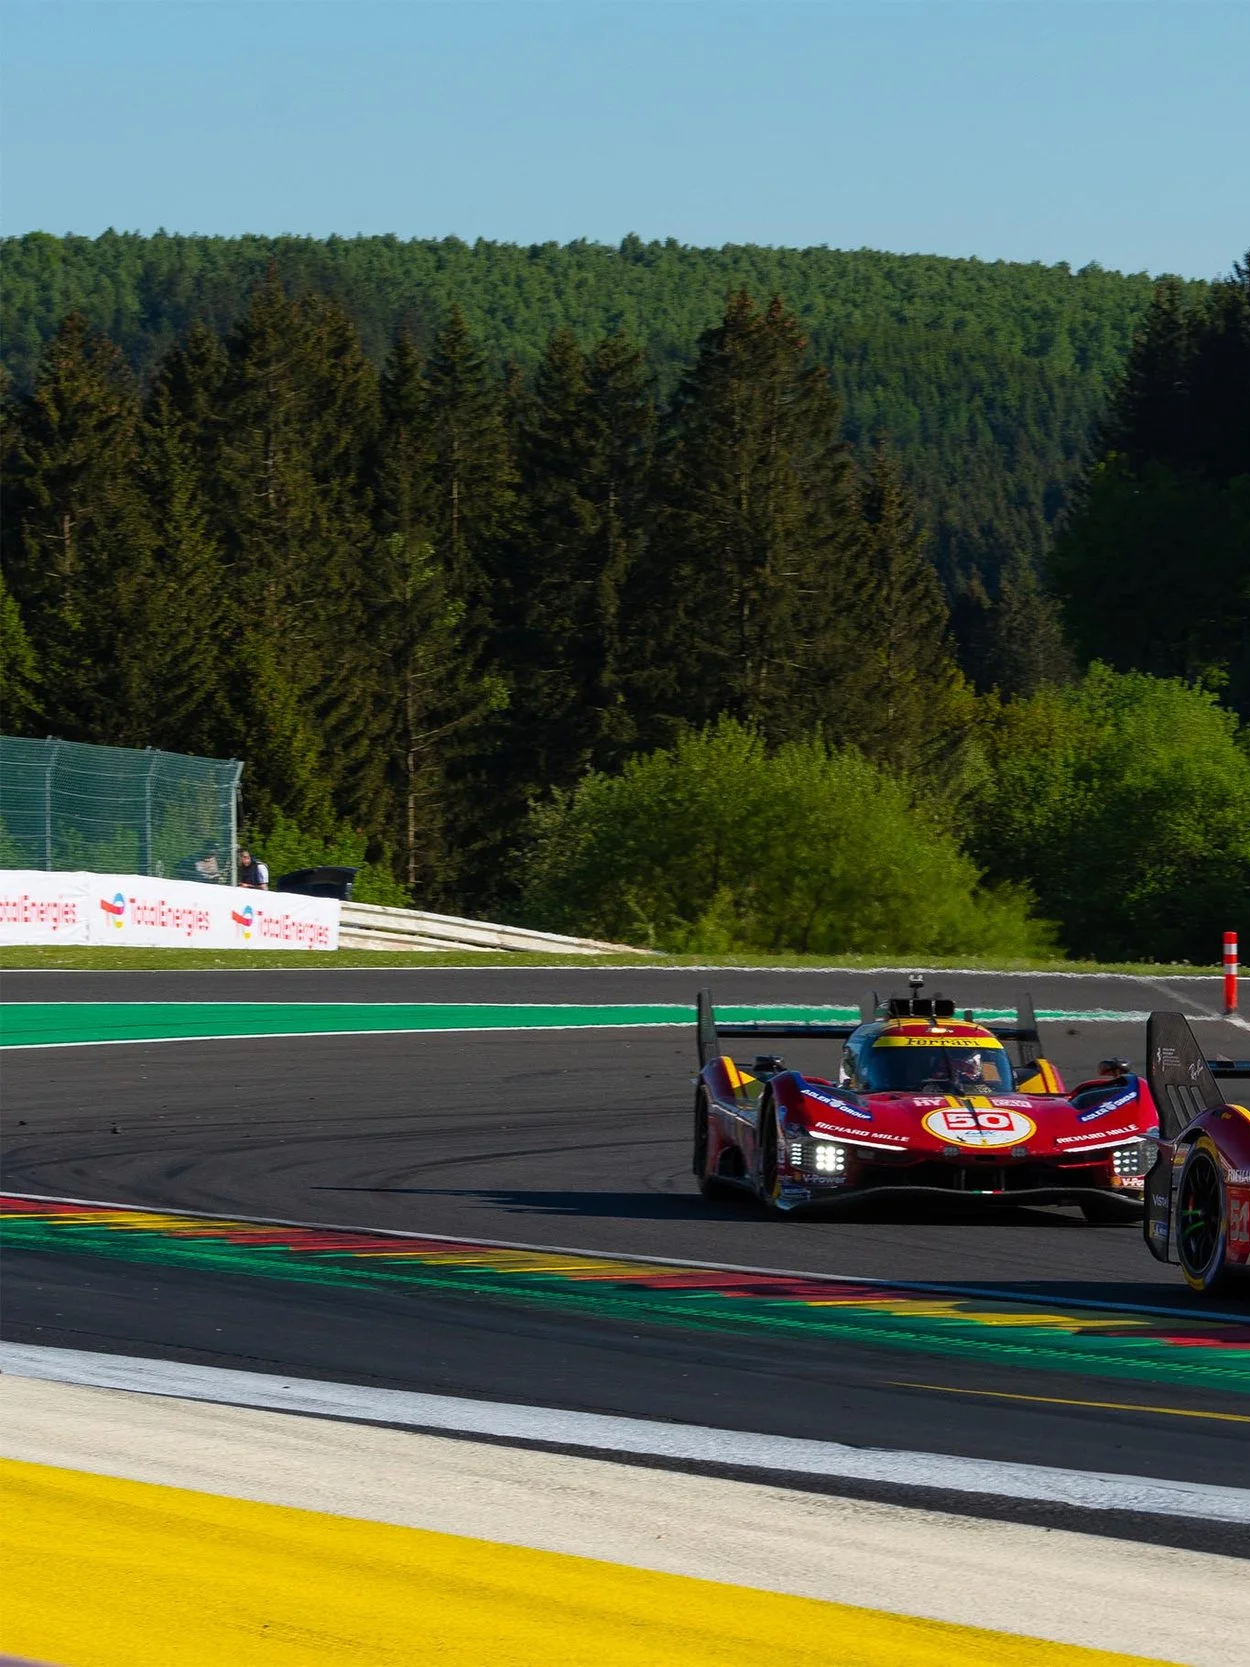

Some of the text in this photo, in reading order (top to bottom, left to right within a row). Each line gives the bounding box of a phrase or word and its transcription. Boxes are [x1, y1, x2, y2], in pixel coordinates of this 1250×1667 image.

[128, 898, 210, 937] TotalEnergies
[257, 910, 330, 950] TotalEnergies
[905, 1037, 980, 1047] Ferrari
[800, 1089, 872, 1119] ADLER GROUP
[815, 1121, 911, 1143] RICHARD MILLE
[947, 1114, 1010, 1129] 50
[1056, 1123, 1140, 1144] RICHARD MILLE
[1229, 1199, 1250, 1242] 51
